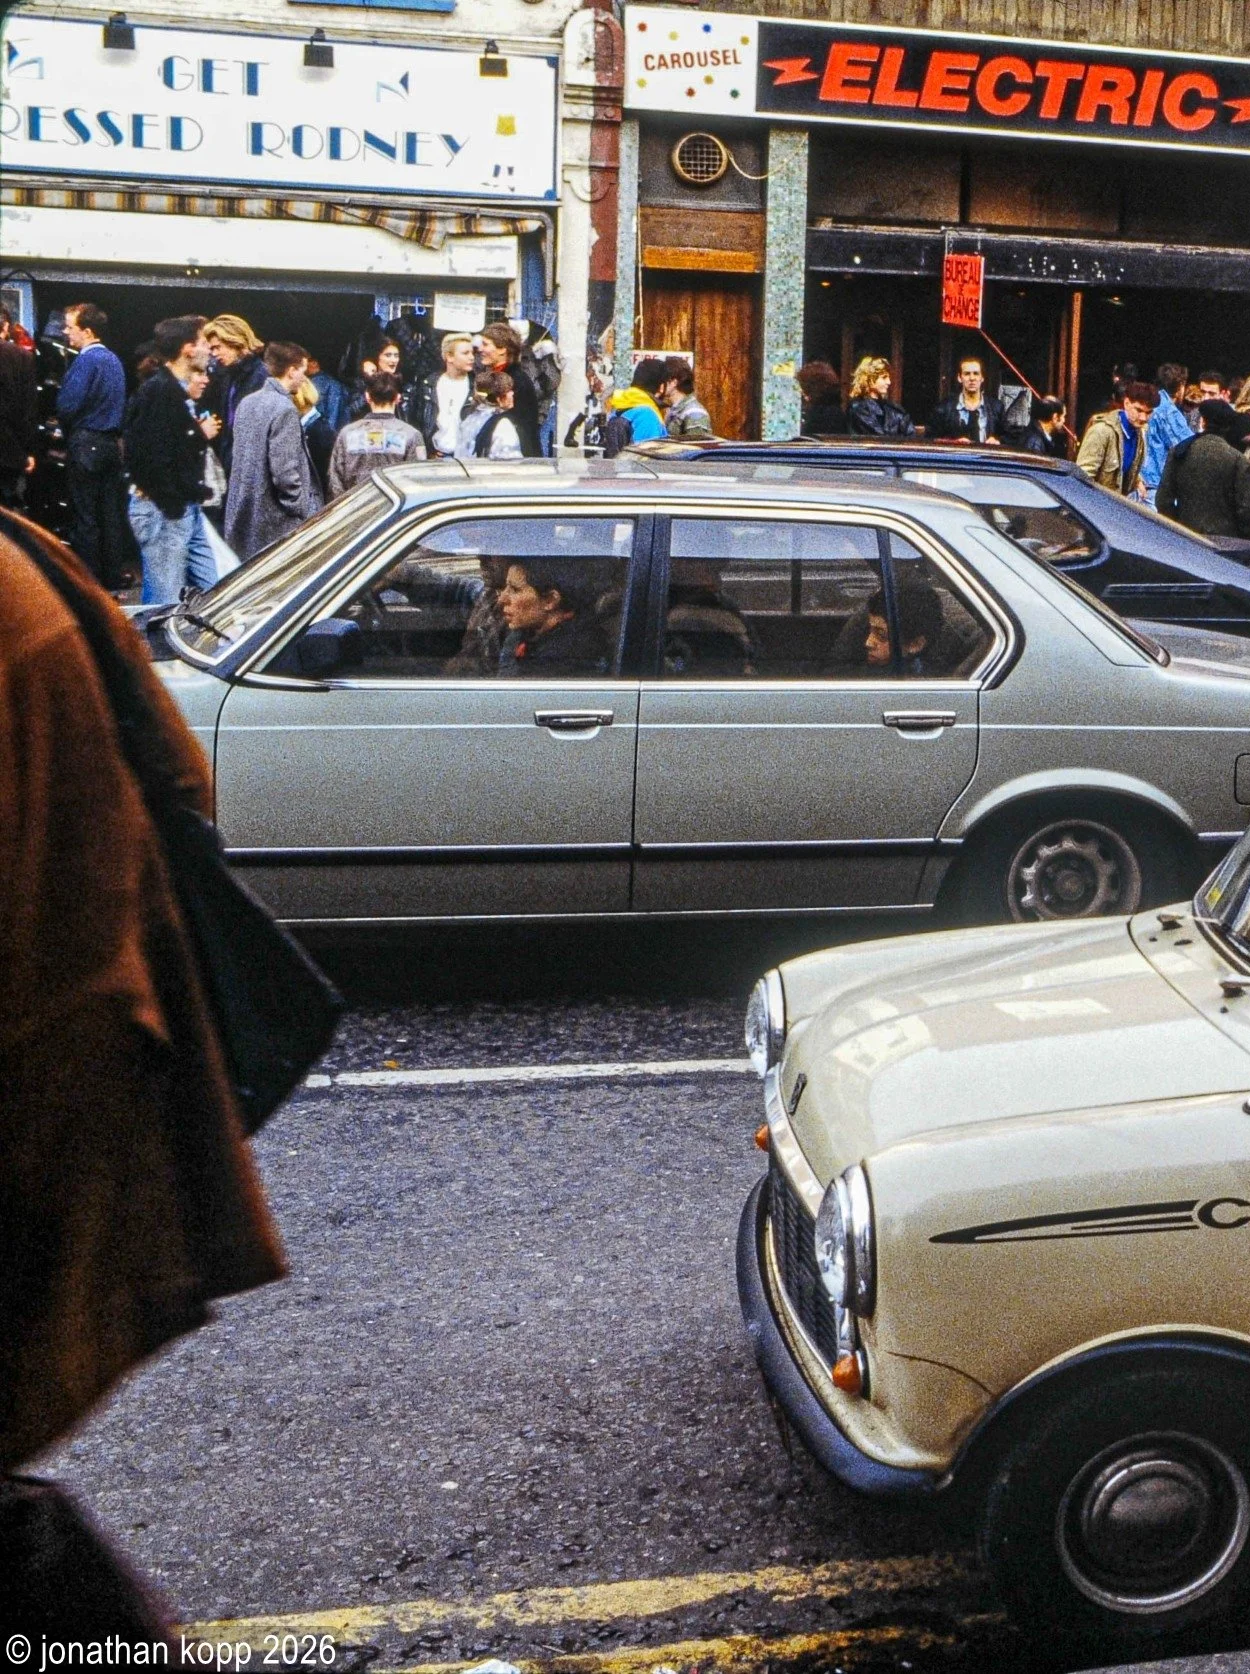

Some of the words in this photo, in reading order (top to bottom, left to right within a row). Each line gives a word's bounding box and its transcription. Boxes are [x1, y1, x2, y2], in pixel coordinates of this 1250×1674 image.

[157, 55, 270, 96] GET
[643, 48, 742, 71] CAROUSEL
[818, 41, 1219, 132] ELECTRIC
[246, 121, 471, 168] RODNEY
[945, 259, 981, 286] BUREAU
[944, 293, 980, 322] CHANGE
